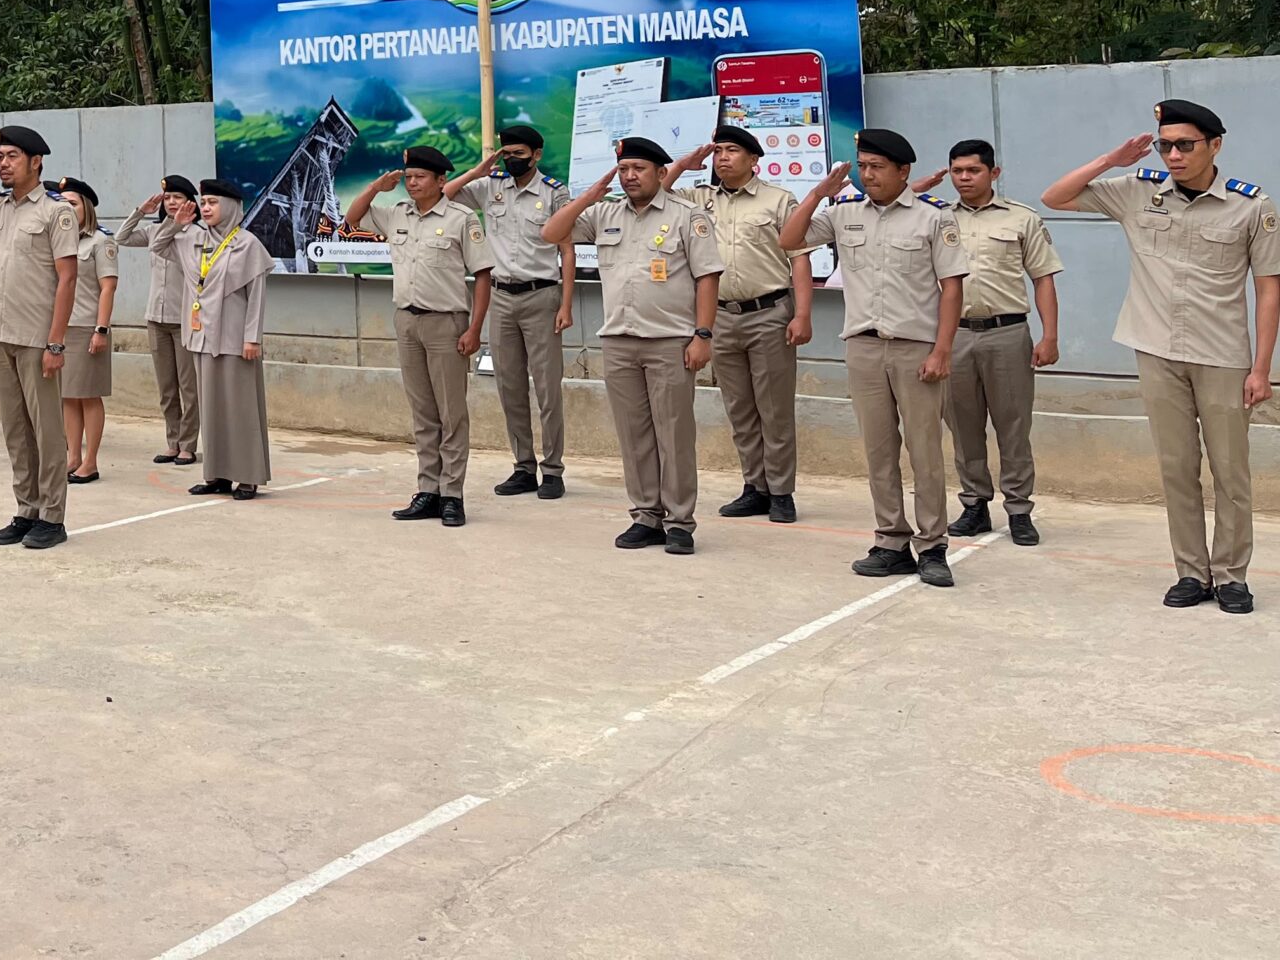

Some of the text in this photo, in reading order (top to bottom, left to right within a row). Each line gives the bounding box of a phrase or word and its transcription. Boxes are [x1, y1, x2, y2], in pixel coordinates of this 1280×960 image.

[279, 35, 357, 66] KANTOR
[500, 14, 635, 52] KABUPATEN
[639, 6, 749, 43] MAMASA
